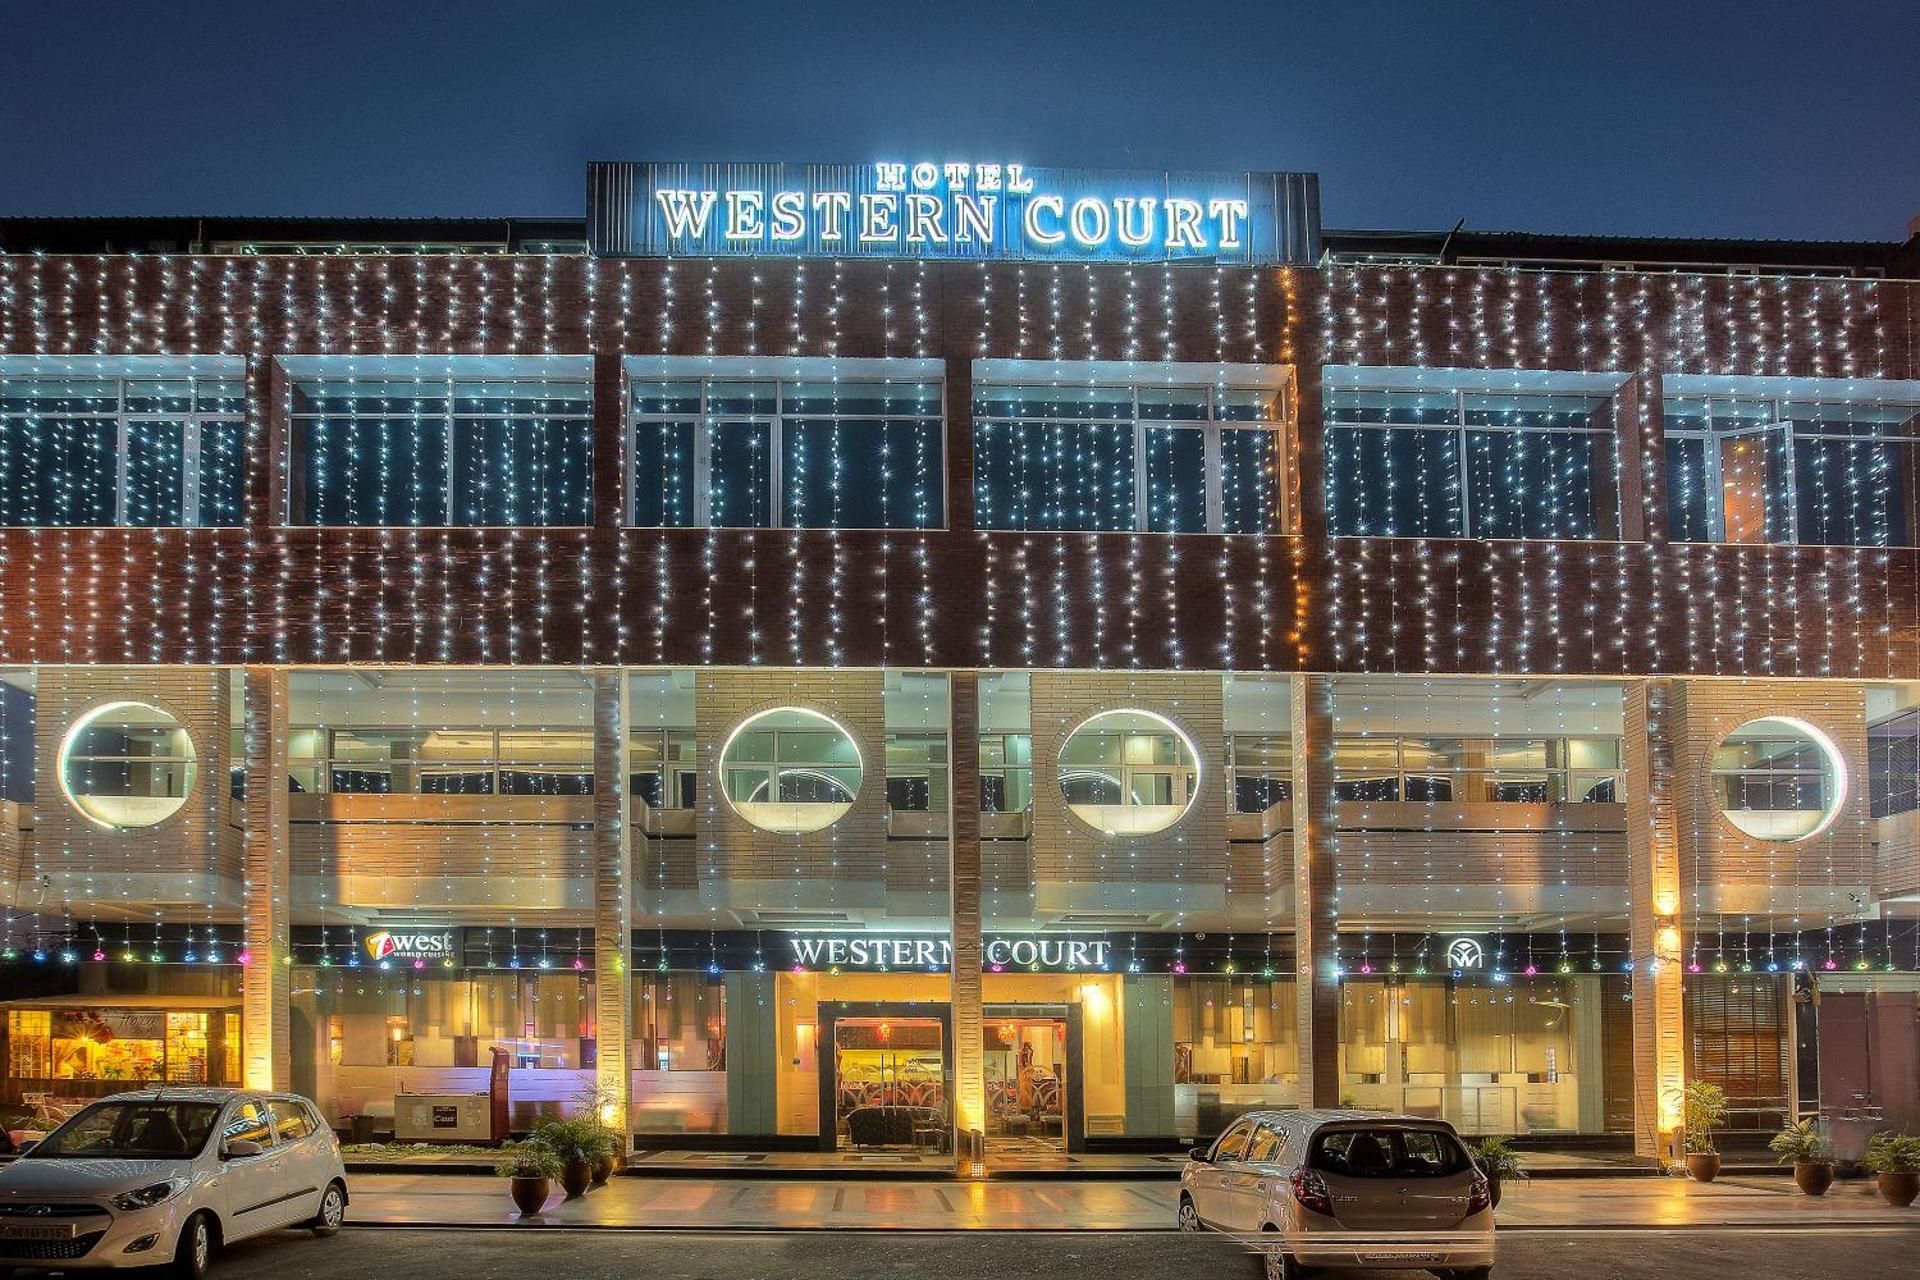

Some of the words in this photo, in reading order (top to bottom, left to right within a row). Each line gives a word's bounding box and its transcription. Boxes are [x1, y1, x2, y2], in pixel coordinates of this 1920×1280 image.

[875, 162, 1034, 193] HOTEL
[655, 189, 998, 244] WESTERN
[1024, 195, 1249, 249] COURT
[987, 940, 1112, 965] COURT
